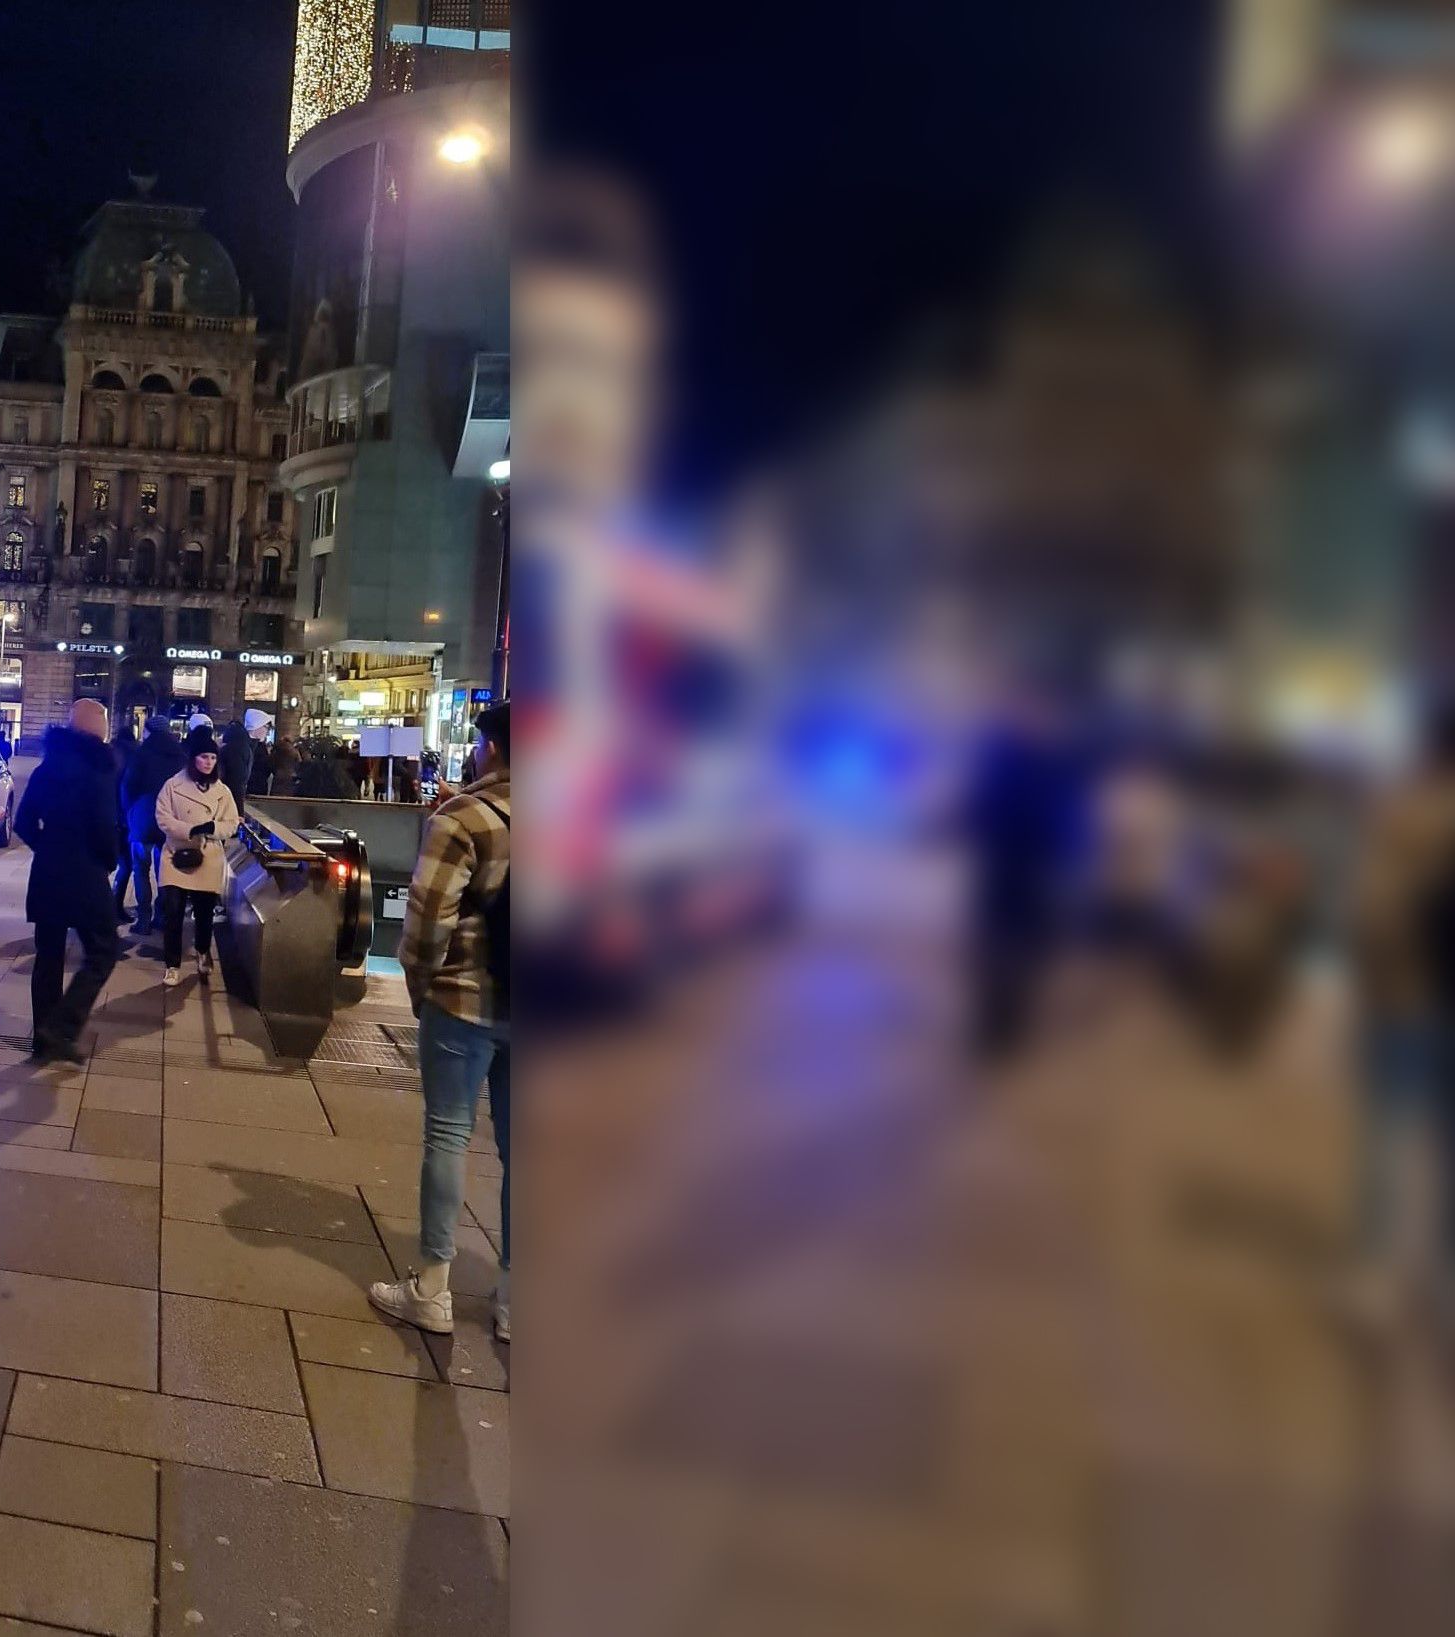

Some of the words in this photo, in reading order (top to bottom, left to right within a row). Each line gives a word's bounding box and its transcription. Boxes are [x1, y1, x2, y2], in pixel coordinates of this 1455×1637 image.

[69, 643, 111, 653] PILSTL
[177, 649, 210, 660] OMEGA
[250, 654, 281, 664] OMEGA
